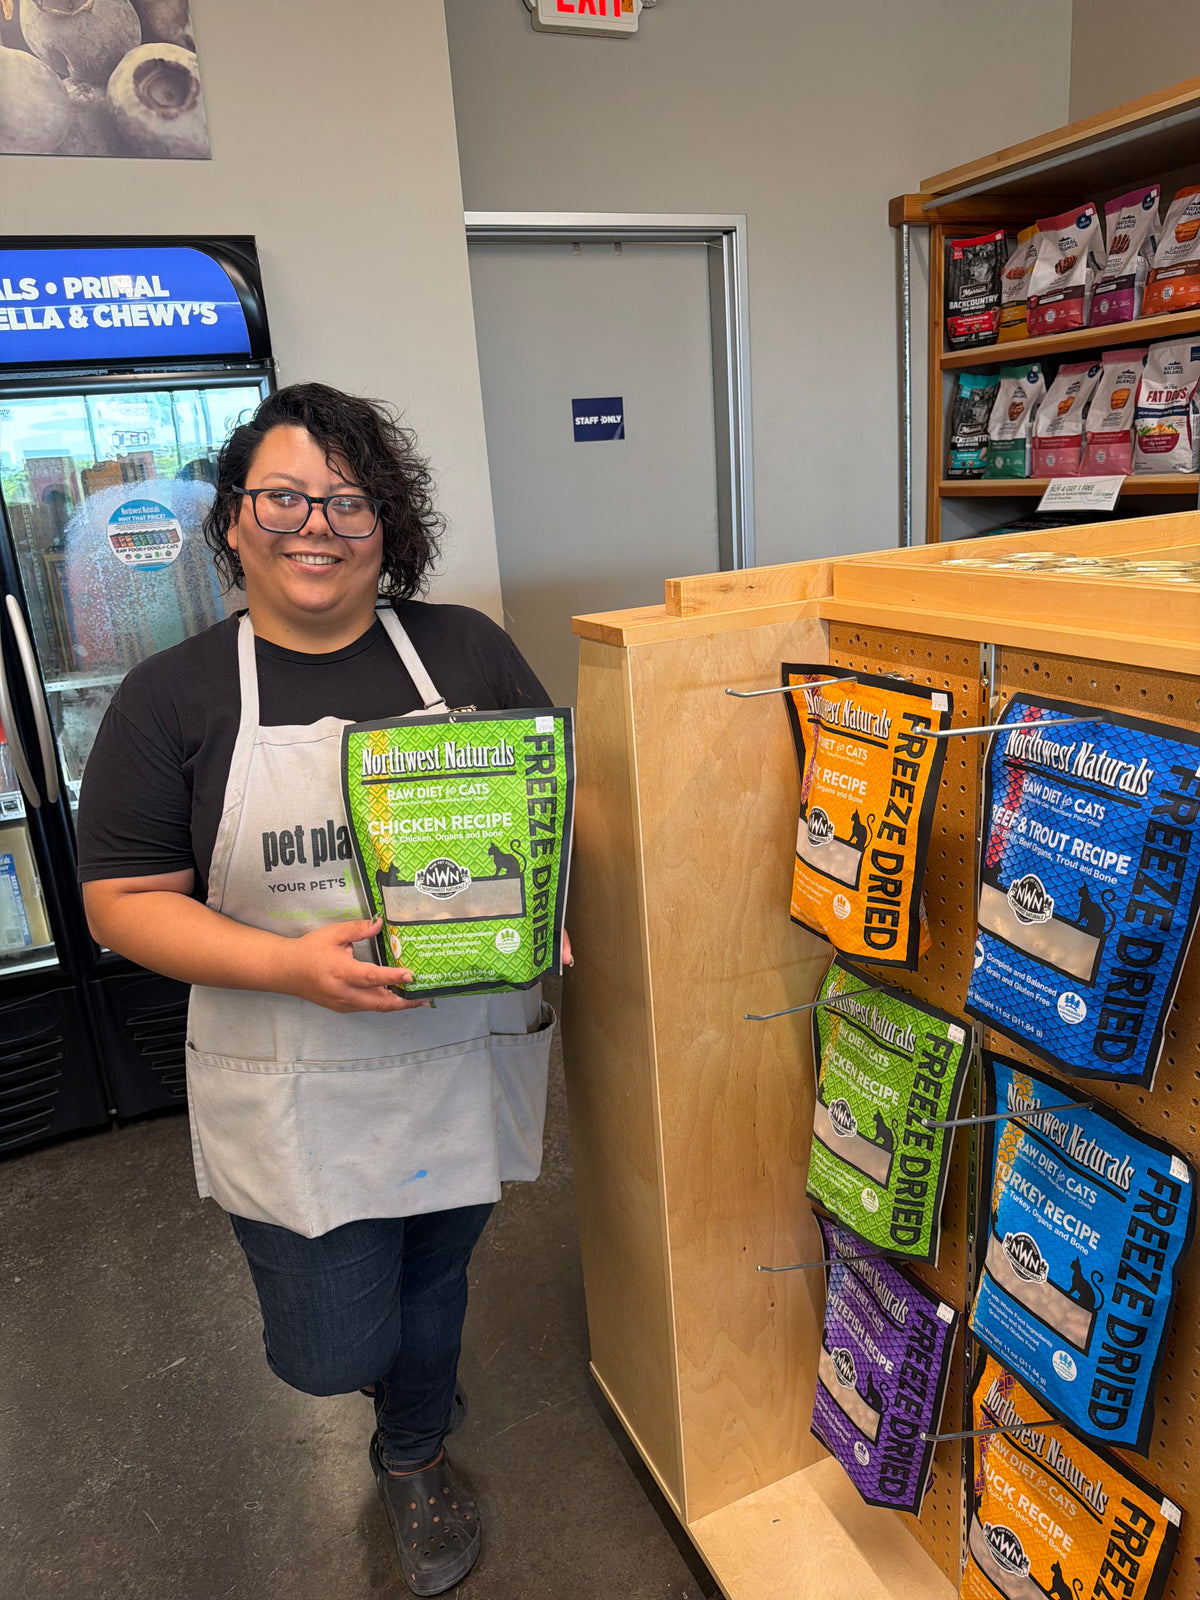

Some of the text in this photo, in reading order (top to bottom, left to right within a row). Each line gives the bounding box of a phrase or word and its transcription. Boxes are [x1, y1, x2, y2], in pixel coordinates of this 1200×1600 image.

[63, 275, 170, 299] PRIMAL
[949, 294, 998, 310] BACKCOUNTRY
[69, 305, 89, 329] &
[93, 303, 218, 327] CHEWY'S
[1146, 391, 1164, 402] FAT
[575, 415, 621, 425] STAFF ONLY
[841, 699, 892, 739] Naturals
[361, 738, 516, 777] Northwest Naturals
[846, 745, 868, 760] CATS
[1004, 729, 1155, 796] Northwest Naturals
[387, 788, 414, 800] RAW
[417, 786, 443, 799] DIET
[459, 783, 489, 796] CATS
[523, 734, 558, 858] FREEZE
[823, 768, 868, 796] RECIPE
[837, 788, 847, 799] and
[848, 793, 863, 804] Bone
[1022, 779, 1043, 797] RAW
[1041, 786, 1062, 805] DIET
[1074, 798, 1106, 821] CATS
[368, 812, 513, 836] CHICKEN RECIPE
[400, 829, 503, 843] Chicken, Organs and Bone
[864, 712, 931, 950] FREEZE DRIED
[992, 804, 1132, 875] BEEF & TROUT RECIPE
[262, 825, 307, 872] pet
[1056, 853, 1079, 869] Trout
[1079, 864, 1092, 876] and
[1093, 869, 1118, 885] Bone
[268, 878, 346, 893] YOUR PET'S
[426, 867, 459, 886] NWN
[1016, 884, 1043, 912] NWN
[532, 864, 553, 967] DRIED
[418, 973, 442, 981] Weight
[985, 966, 1050, 1007] Grain and Gluten Free
[986, 952, 1058, 996] Complete and Balanced
[974, 993, 1044, 1038] Weight 11 oz g)
[1093, 935, 1164, 1064] DRIED
[848, 1032, 890, 1067] DIET CATS
[869, 1007, 917, 1053] Naturals
[856, 1071, 900, 1106] RECIPE
[890, 1032, 954, 1246] FREEZE DRIED
[1066, 1123, 1135, 1191] Naturals
[1016, 1137, 1098, 1204] RAW DIET CATS
[997, 1159, 1101, 1251] TURKEY RECIPE
[1010, 1189, 1089, 1256] Turkey, Organs and Bone
[1011, 1242, 1040, 1273] NWN
[842, 1273, 885, 1332] RAW DIET CATS
[874, 1271, 909, 1325] Naturals
[1088, 1168, 1182, 1431] FREEZE DRIED
[827, 1290, 895, 1375] HITEFISH RECIPE
[878, 1310, 938, 1498] FREEZE DRIED
[989, 1433, 1077, 1516] RAW DIET CATS
[1045, 1437, 1110, 1516] Naturals
[1007, 1502, 1033, 1528] Organs
[1033, 1526, 1048, 1541] and
[1048, 1539, 1067, 1560] Bone
[1017, 1493, 1074, 1552] RECIPE
[990, 1533, 1022, 1567] NWN
